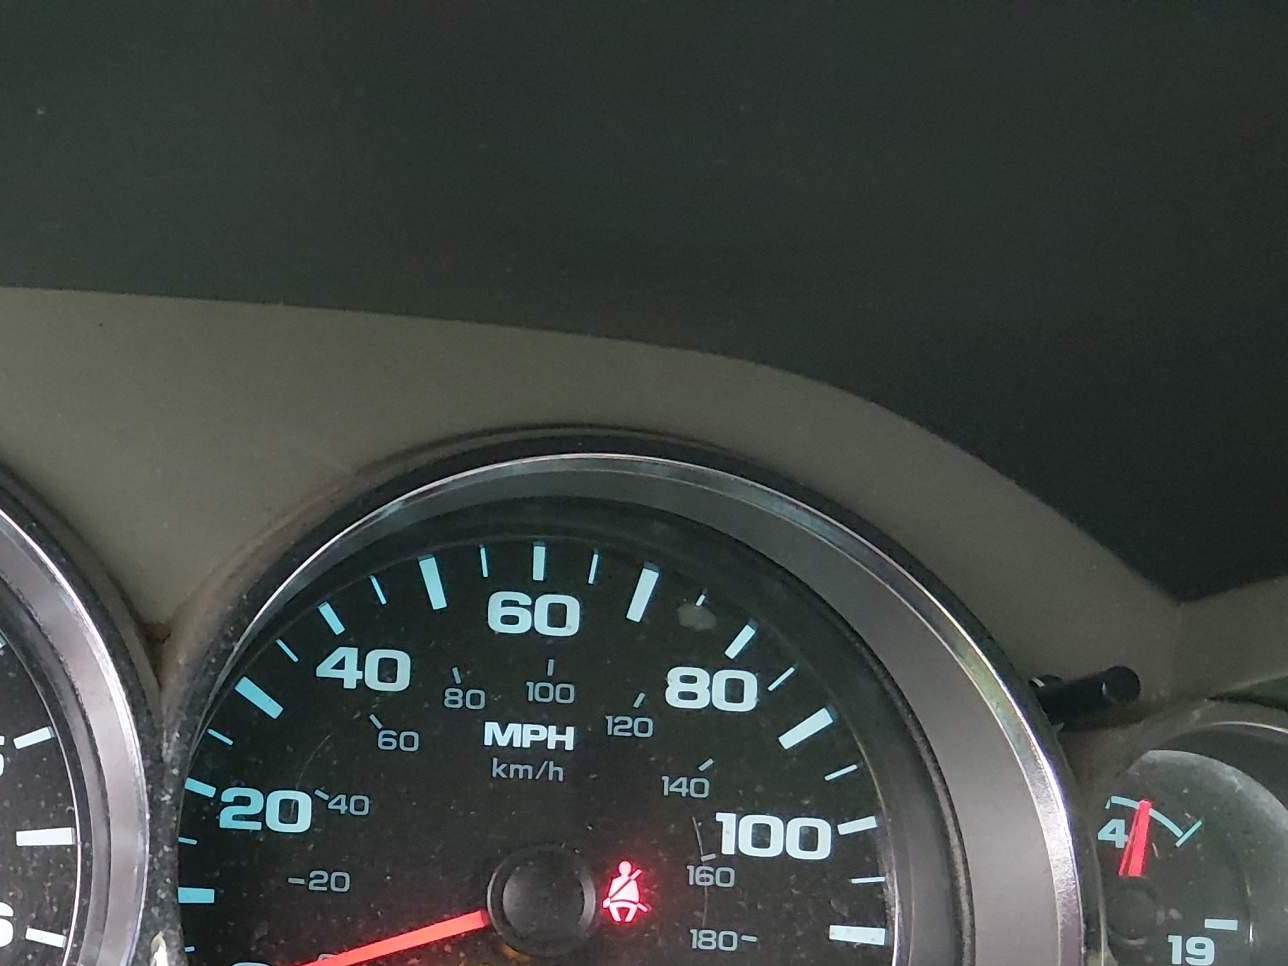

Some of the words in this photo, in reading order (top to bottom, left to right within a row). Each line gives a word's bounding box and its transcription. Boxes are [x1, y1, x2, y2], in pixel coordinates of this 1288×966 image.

[487, 591, 581, 637] 60
[315, 646, 411, 691] 40
[444, 688, 486, 710] 80
[525, 681, 575, 704] 100
[665, 666, 758, 712] 80
[483, 721, 574, 751] MPH
[606, 715, 654, 738] 120
[377, 729, 420, 752] 60
[492, 757, 564, 783] km/h
[661, 776, 710, 798] 140
[219, 787, 312, 832] 20
[327, 794, 370, 816] 40
[715, 812, 832, 860] 100
[308, 870, 351, 893] 20
[686, 864, 735, 888] 160
[690, 929, 738, 952] 180
[1167, 934, 1215, 966] 19
